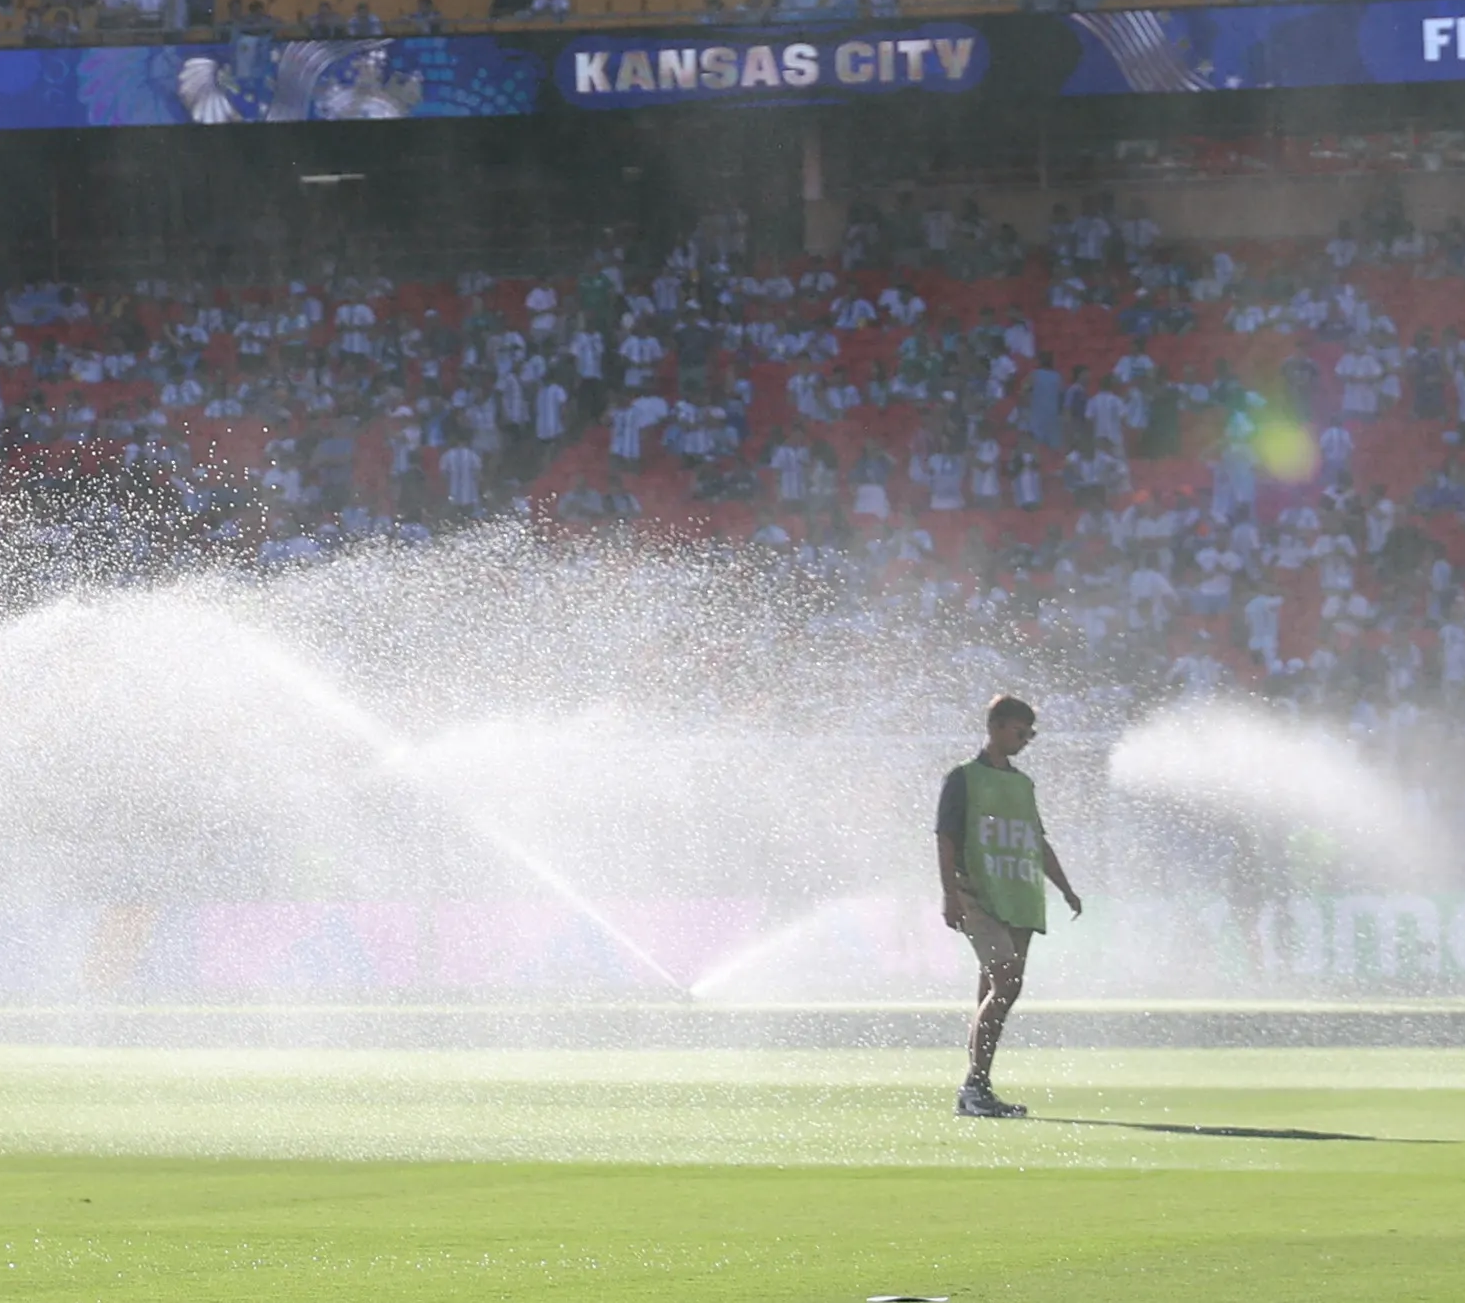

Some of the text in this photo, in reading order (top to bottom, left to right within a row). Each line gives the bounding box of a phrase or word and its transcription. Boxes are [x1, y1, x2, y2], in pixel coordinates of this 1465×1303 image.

[574, 38, 974, 93] KANSAS CITY
[978, 814, 1039, 852] FIFA
